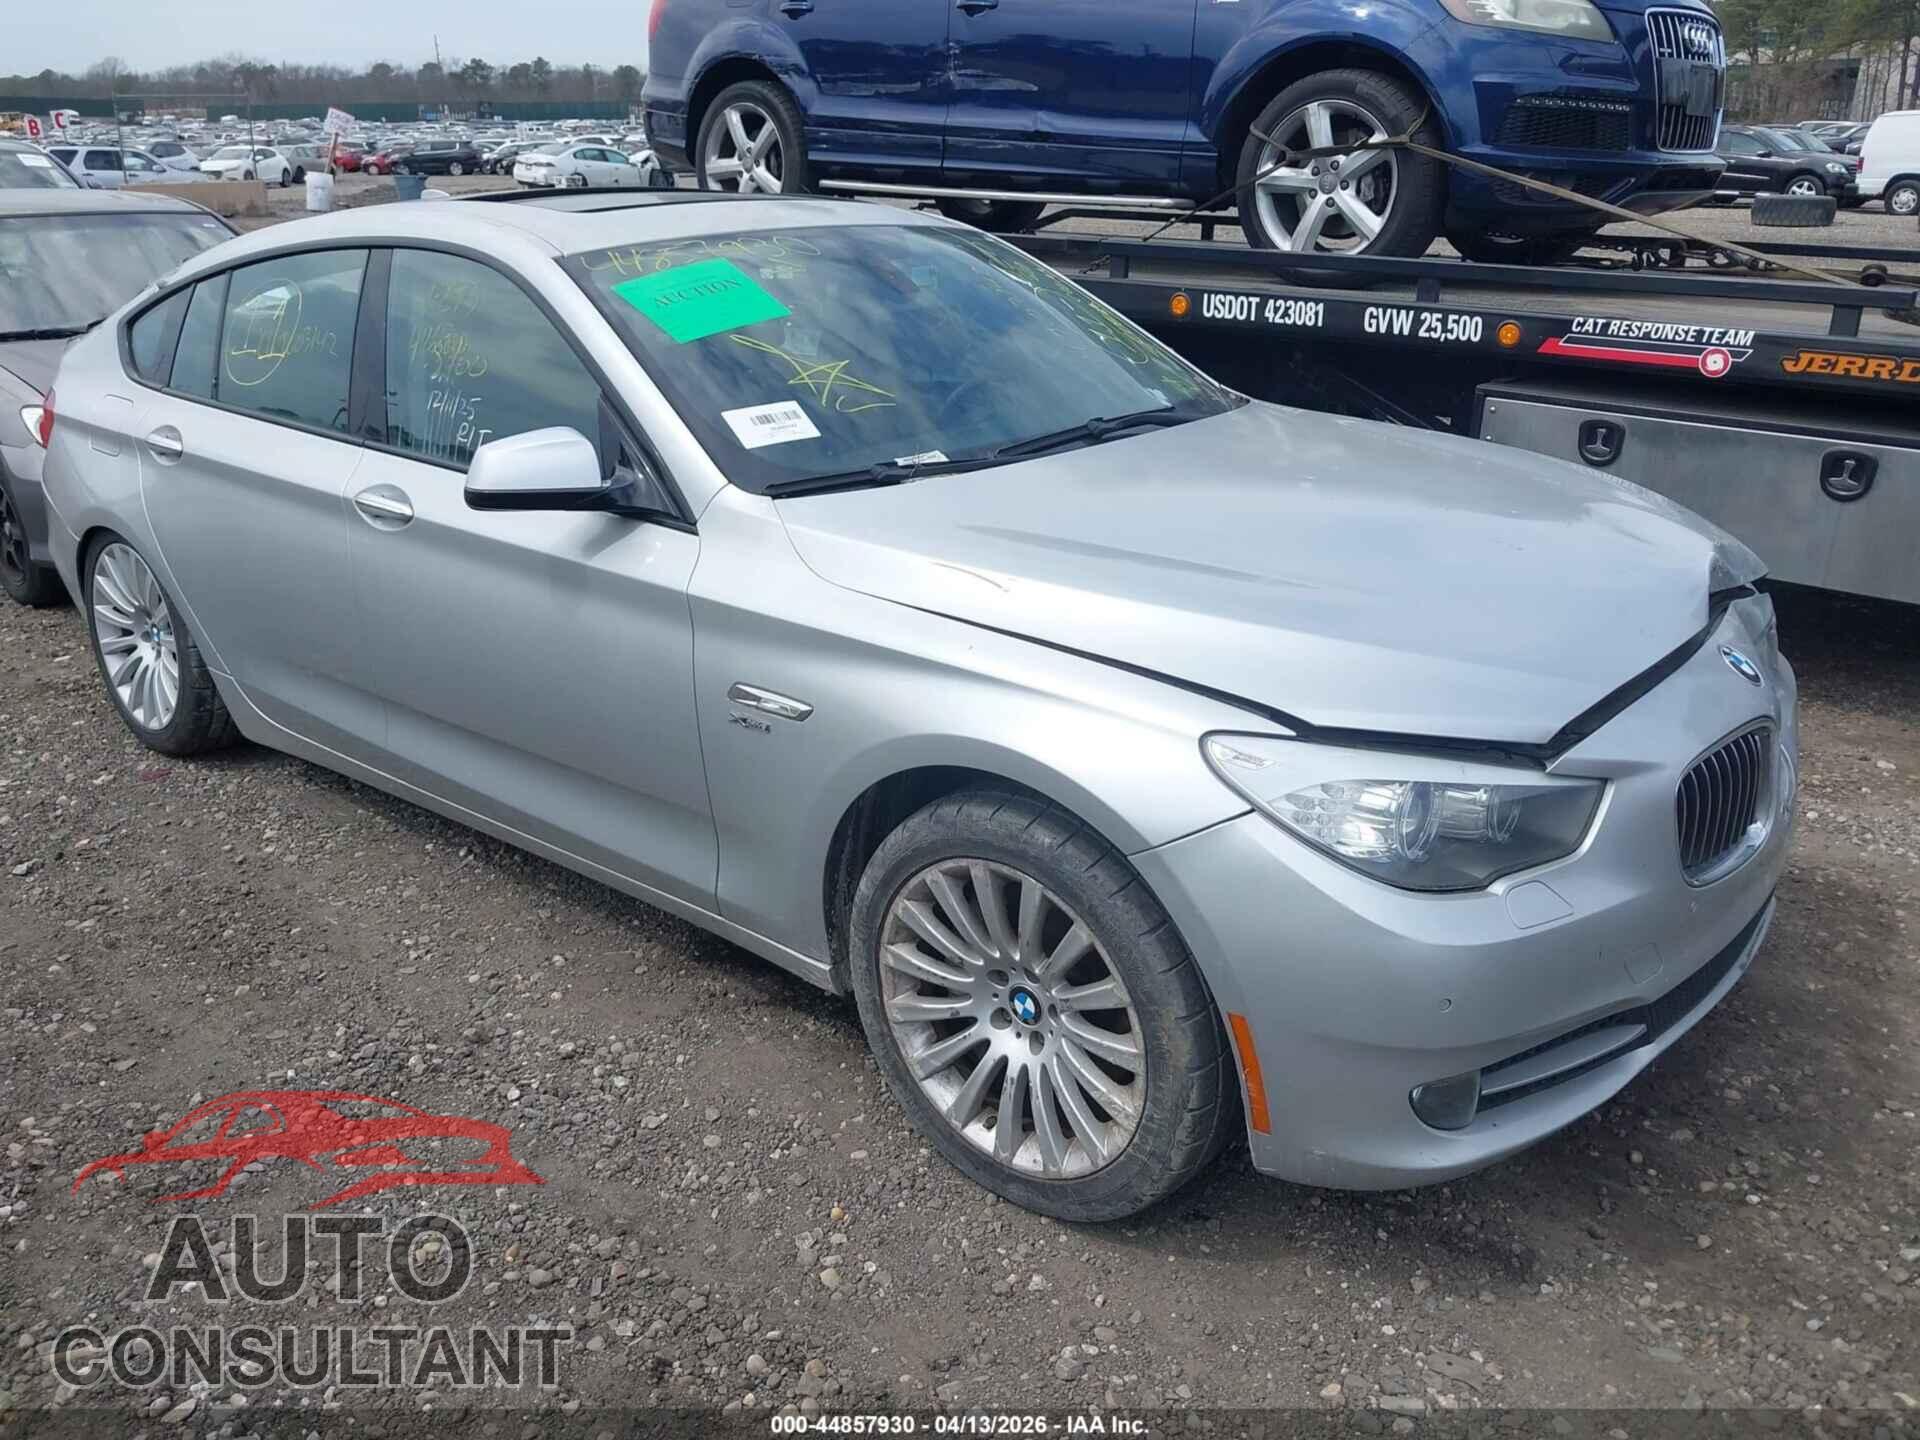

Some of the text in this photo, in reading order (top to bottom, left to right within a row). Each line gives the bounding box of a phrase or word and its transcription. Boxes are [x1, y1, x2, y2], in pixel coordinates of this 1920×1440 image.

[28, 118, 41, 136] B
[54, 112, 67, 129] C
[654, 278, 743, 310] AUCTION
[1202, 292, 1325, 327] USDOT 423081
[1363, 306, 1483, 342] GVW 25,500
[1571, 317, 1755, 346] CAT RESPONSE TEAM
